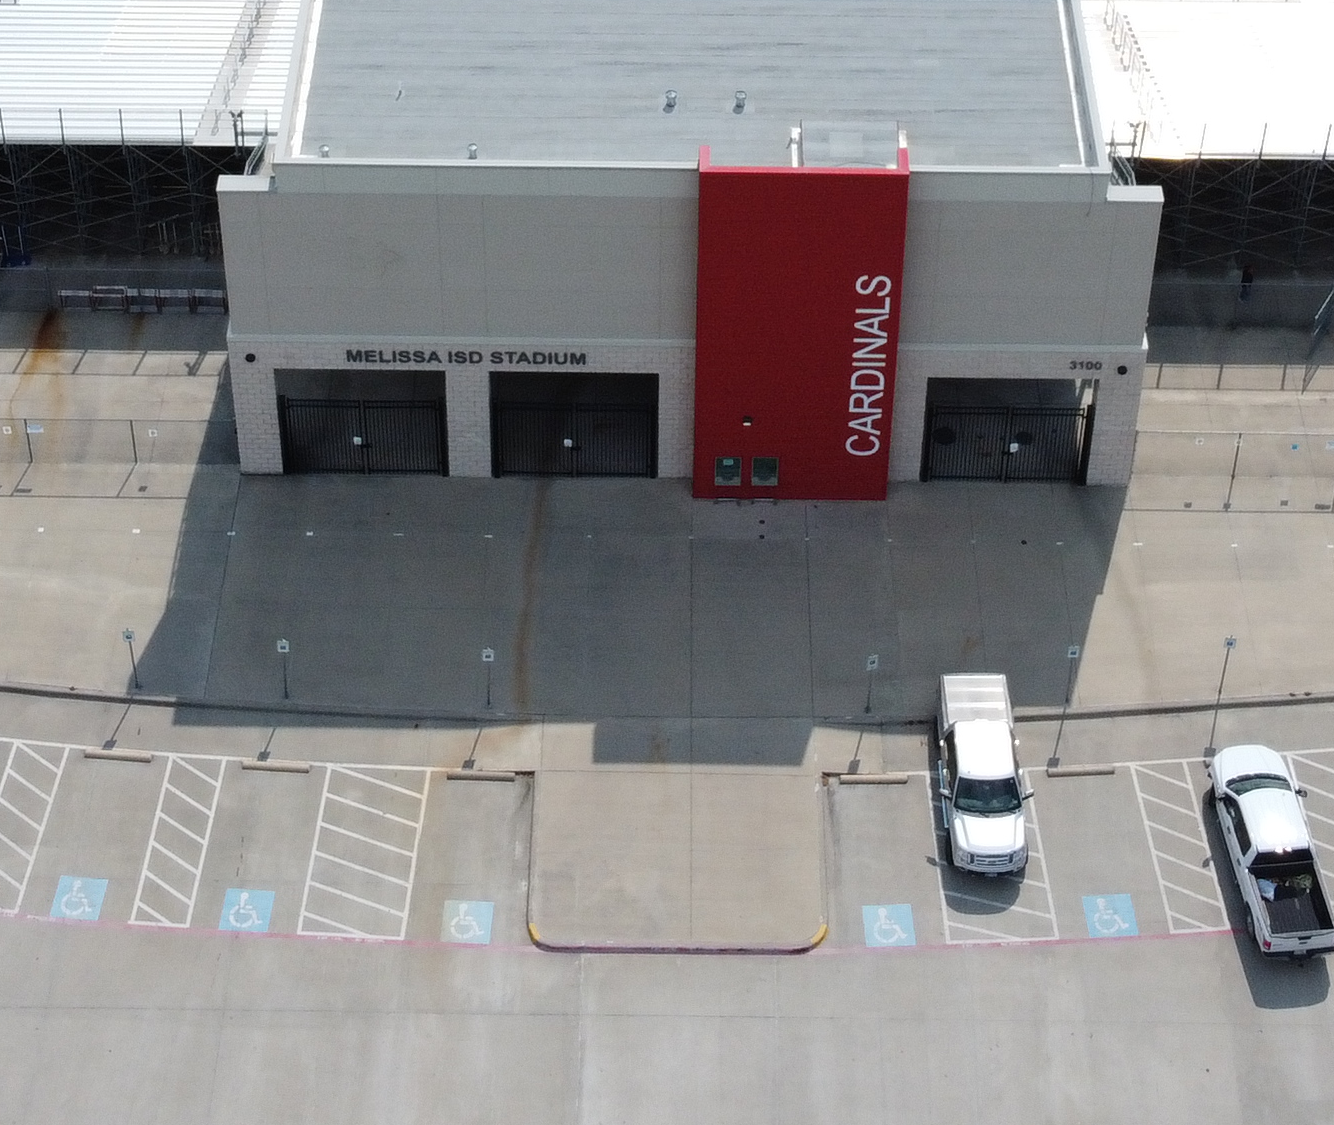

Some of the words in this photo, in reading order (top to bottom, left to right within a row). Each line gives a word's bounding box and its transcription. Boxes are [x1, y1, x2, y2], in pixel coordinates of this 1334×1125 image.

[346, 349, 442, 364] MELISSA
[448, 350, 483, 364] ISD
[490, 351, 587, 365] STADIUM
[845, 275, 892, 457] CARDINALS
[1069, 360, 1103, 371] 3100
